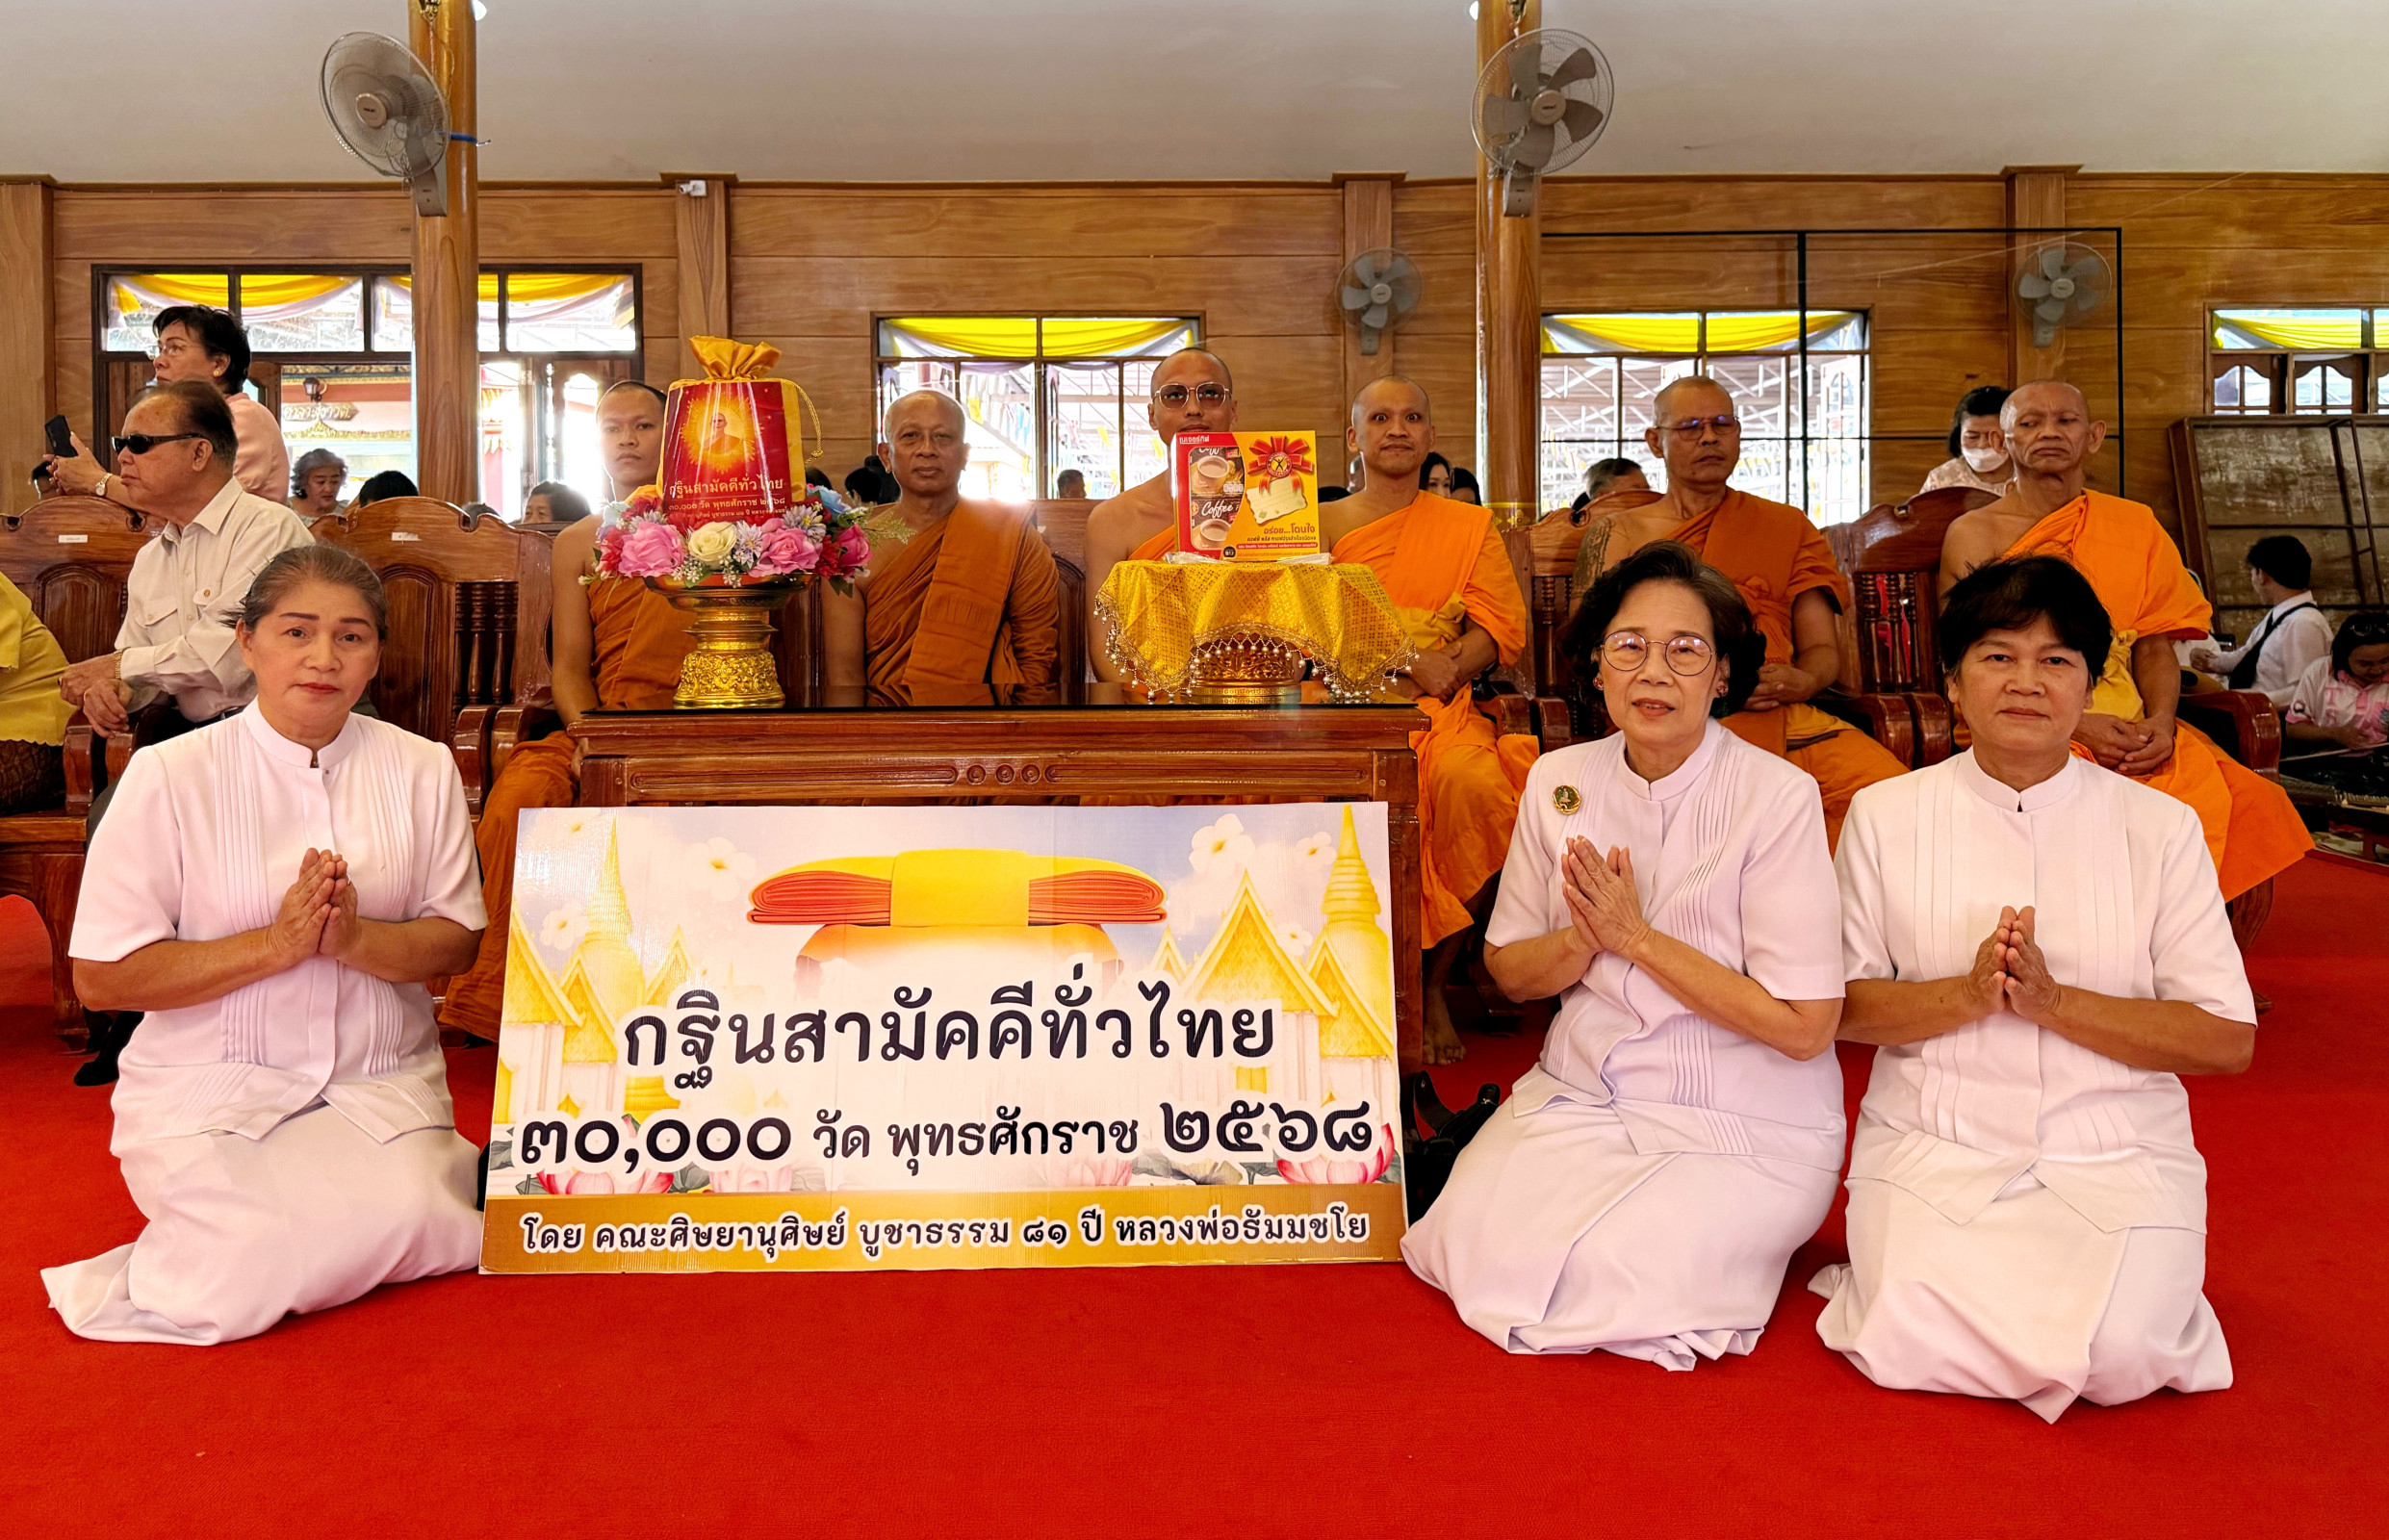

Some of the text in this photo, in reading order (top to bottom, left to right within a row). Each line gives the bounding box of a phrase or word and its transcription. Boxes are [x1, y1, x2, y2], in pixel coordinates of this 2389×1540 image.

[1201, 500, 1234, 519] Coffee
[625, 962, 1273, 1090] กฐินสามัคคีทั่วไทย
[521, 1099, 1373, 1176] ๓๐,๐๐๐ วัด พุทธศักราช ๒๕๖๘
[524, 1206, 1367, 1258] โดย คณะศิษยานุศิษย์ บูชาธรรม ๘๑ ปี หลวงพ่อธัมมชโย
